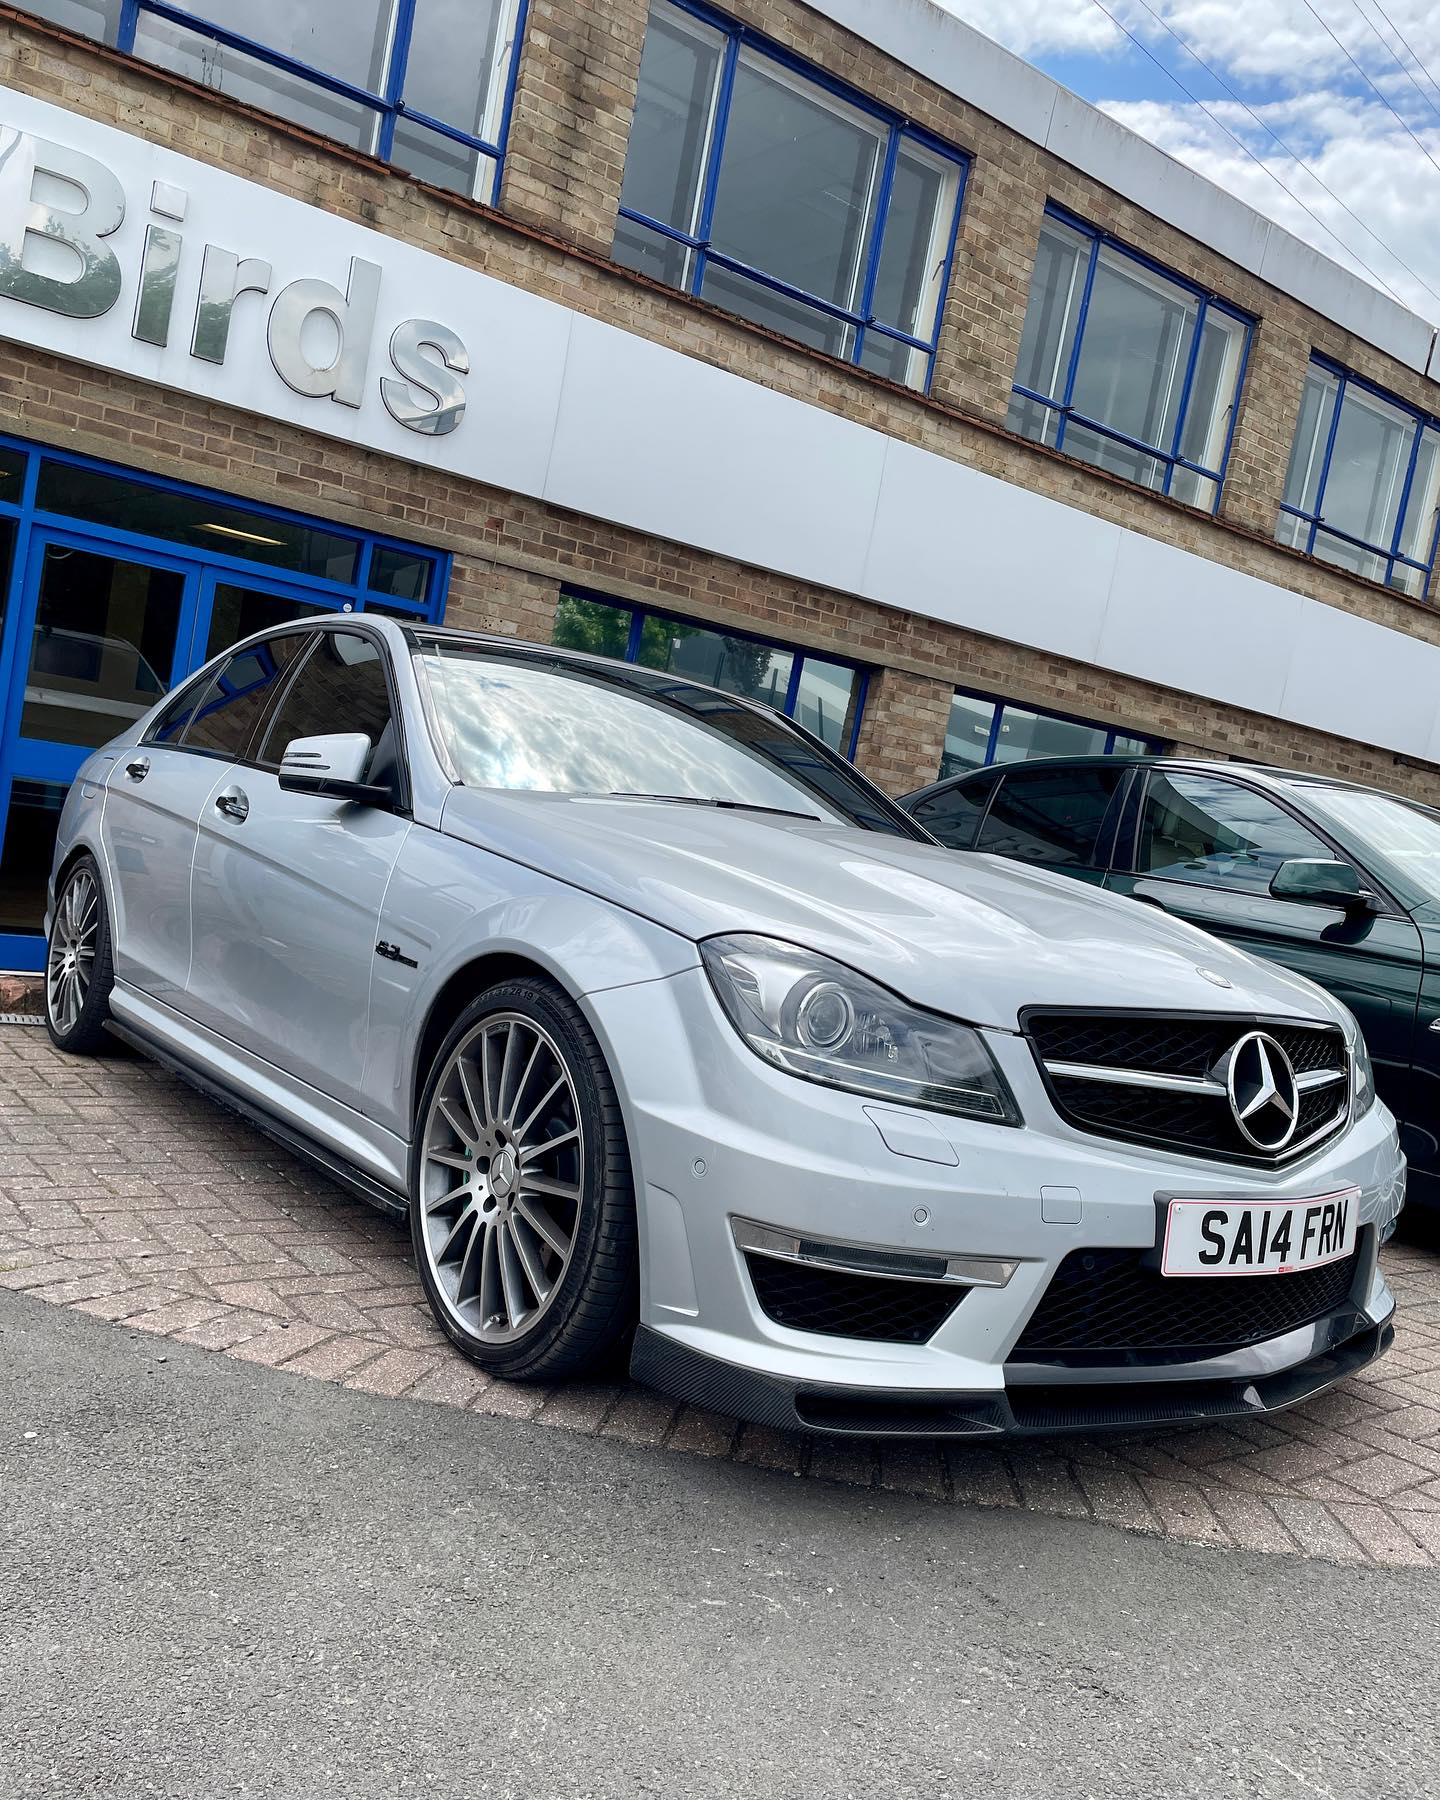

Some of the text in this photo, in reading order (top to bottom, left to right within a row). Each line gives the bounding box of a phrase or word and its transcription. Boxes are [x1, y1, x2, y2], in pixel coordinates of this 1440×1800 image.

[0, 126, 470, 436] Birds
[1198, 1200, 1349, 1265] SA14 FRN
